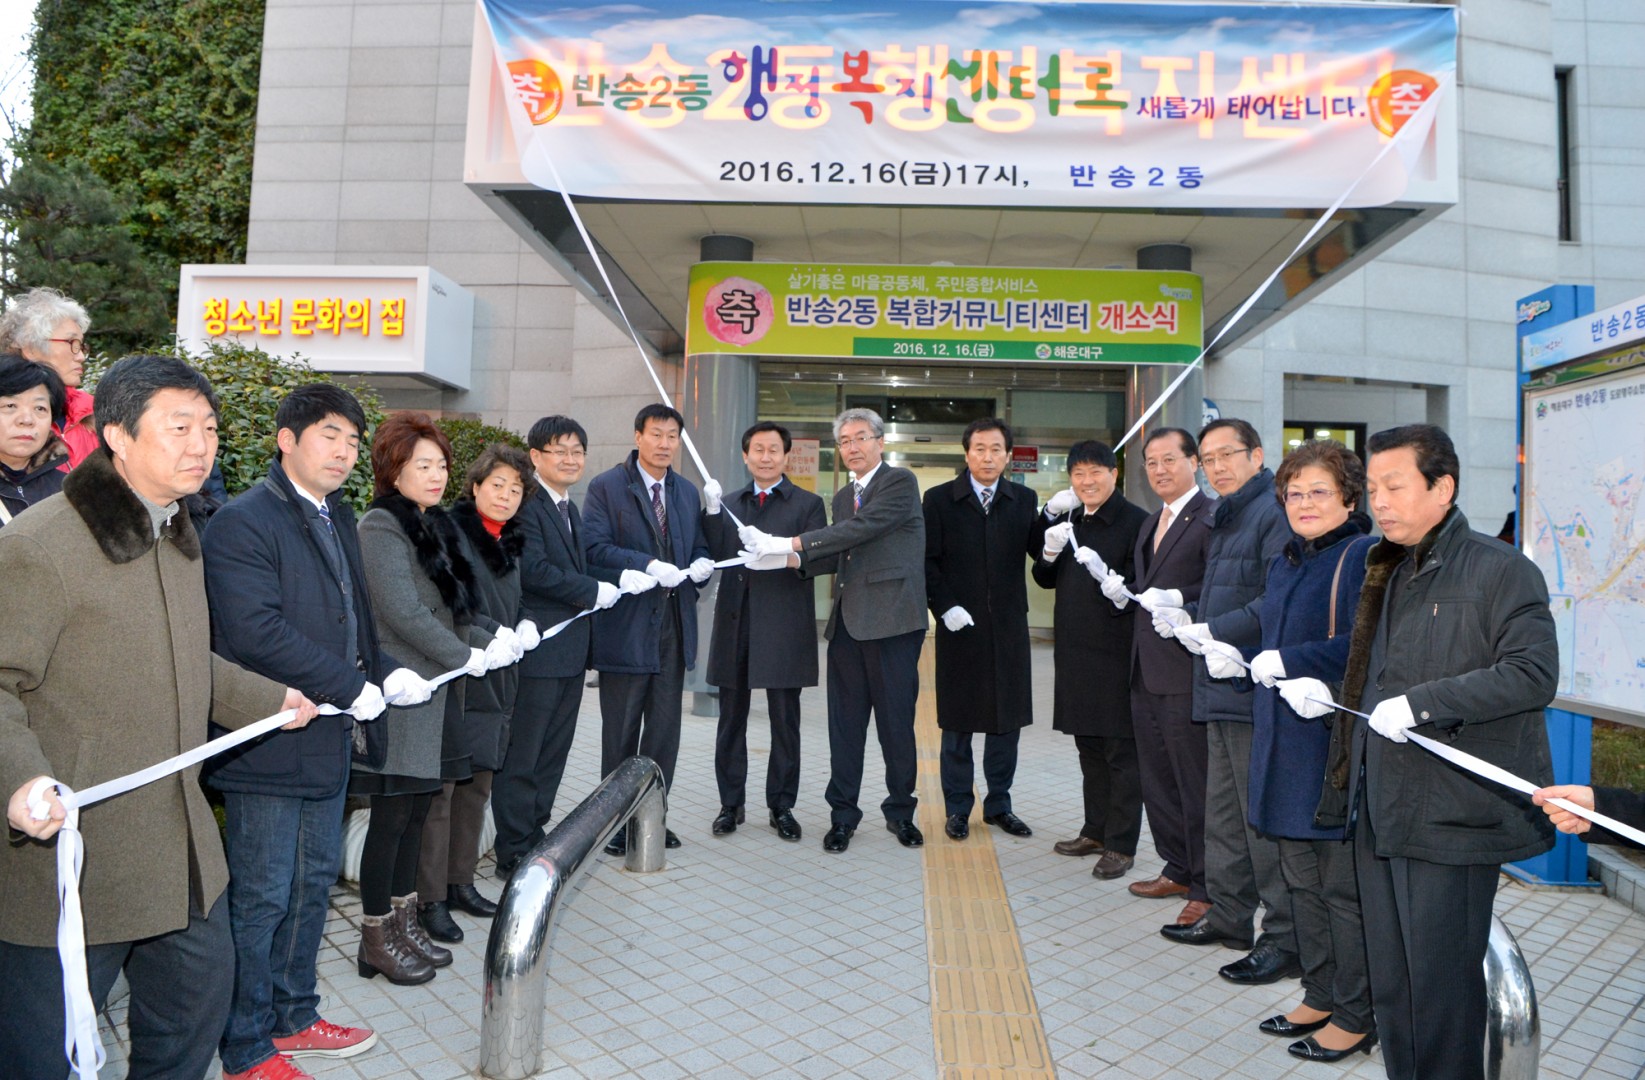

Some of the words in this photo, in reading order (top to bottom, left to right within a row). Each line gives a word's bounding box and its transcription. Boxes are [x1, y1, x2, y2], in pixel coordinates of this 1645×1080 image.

[572, 72, 712, 111] 반송2동
[1136, 95, 1215, 120] 새롭게
[1227, 95, 1366, 121] 태어납니다.
[788, 272, 846, 291] 살기좋은
[851, 274, 930, 292] 마을공동체,
[935, 275, 1039, 294] 주민종합서비스
[202, 297, 282, 336] 청소년
[289, 297, 370, 336] 문화의
[380, 298, 406, 336] 집
[716, 289, 761, 335] 축
[787, 296, 878, 326] 반송2동
[886, 298, 1089, 330] 복합커뮤니티센터
[1099, 303, 1176, 332] 개소식
[1591, 305, 1645, 342] 반송2동
[1053, 345, 1104, 359] 해운대구
